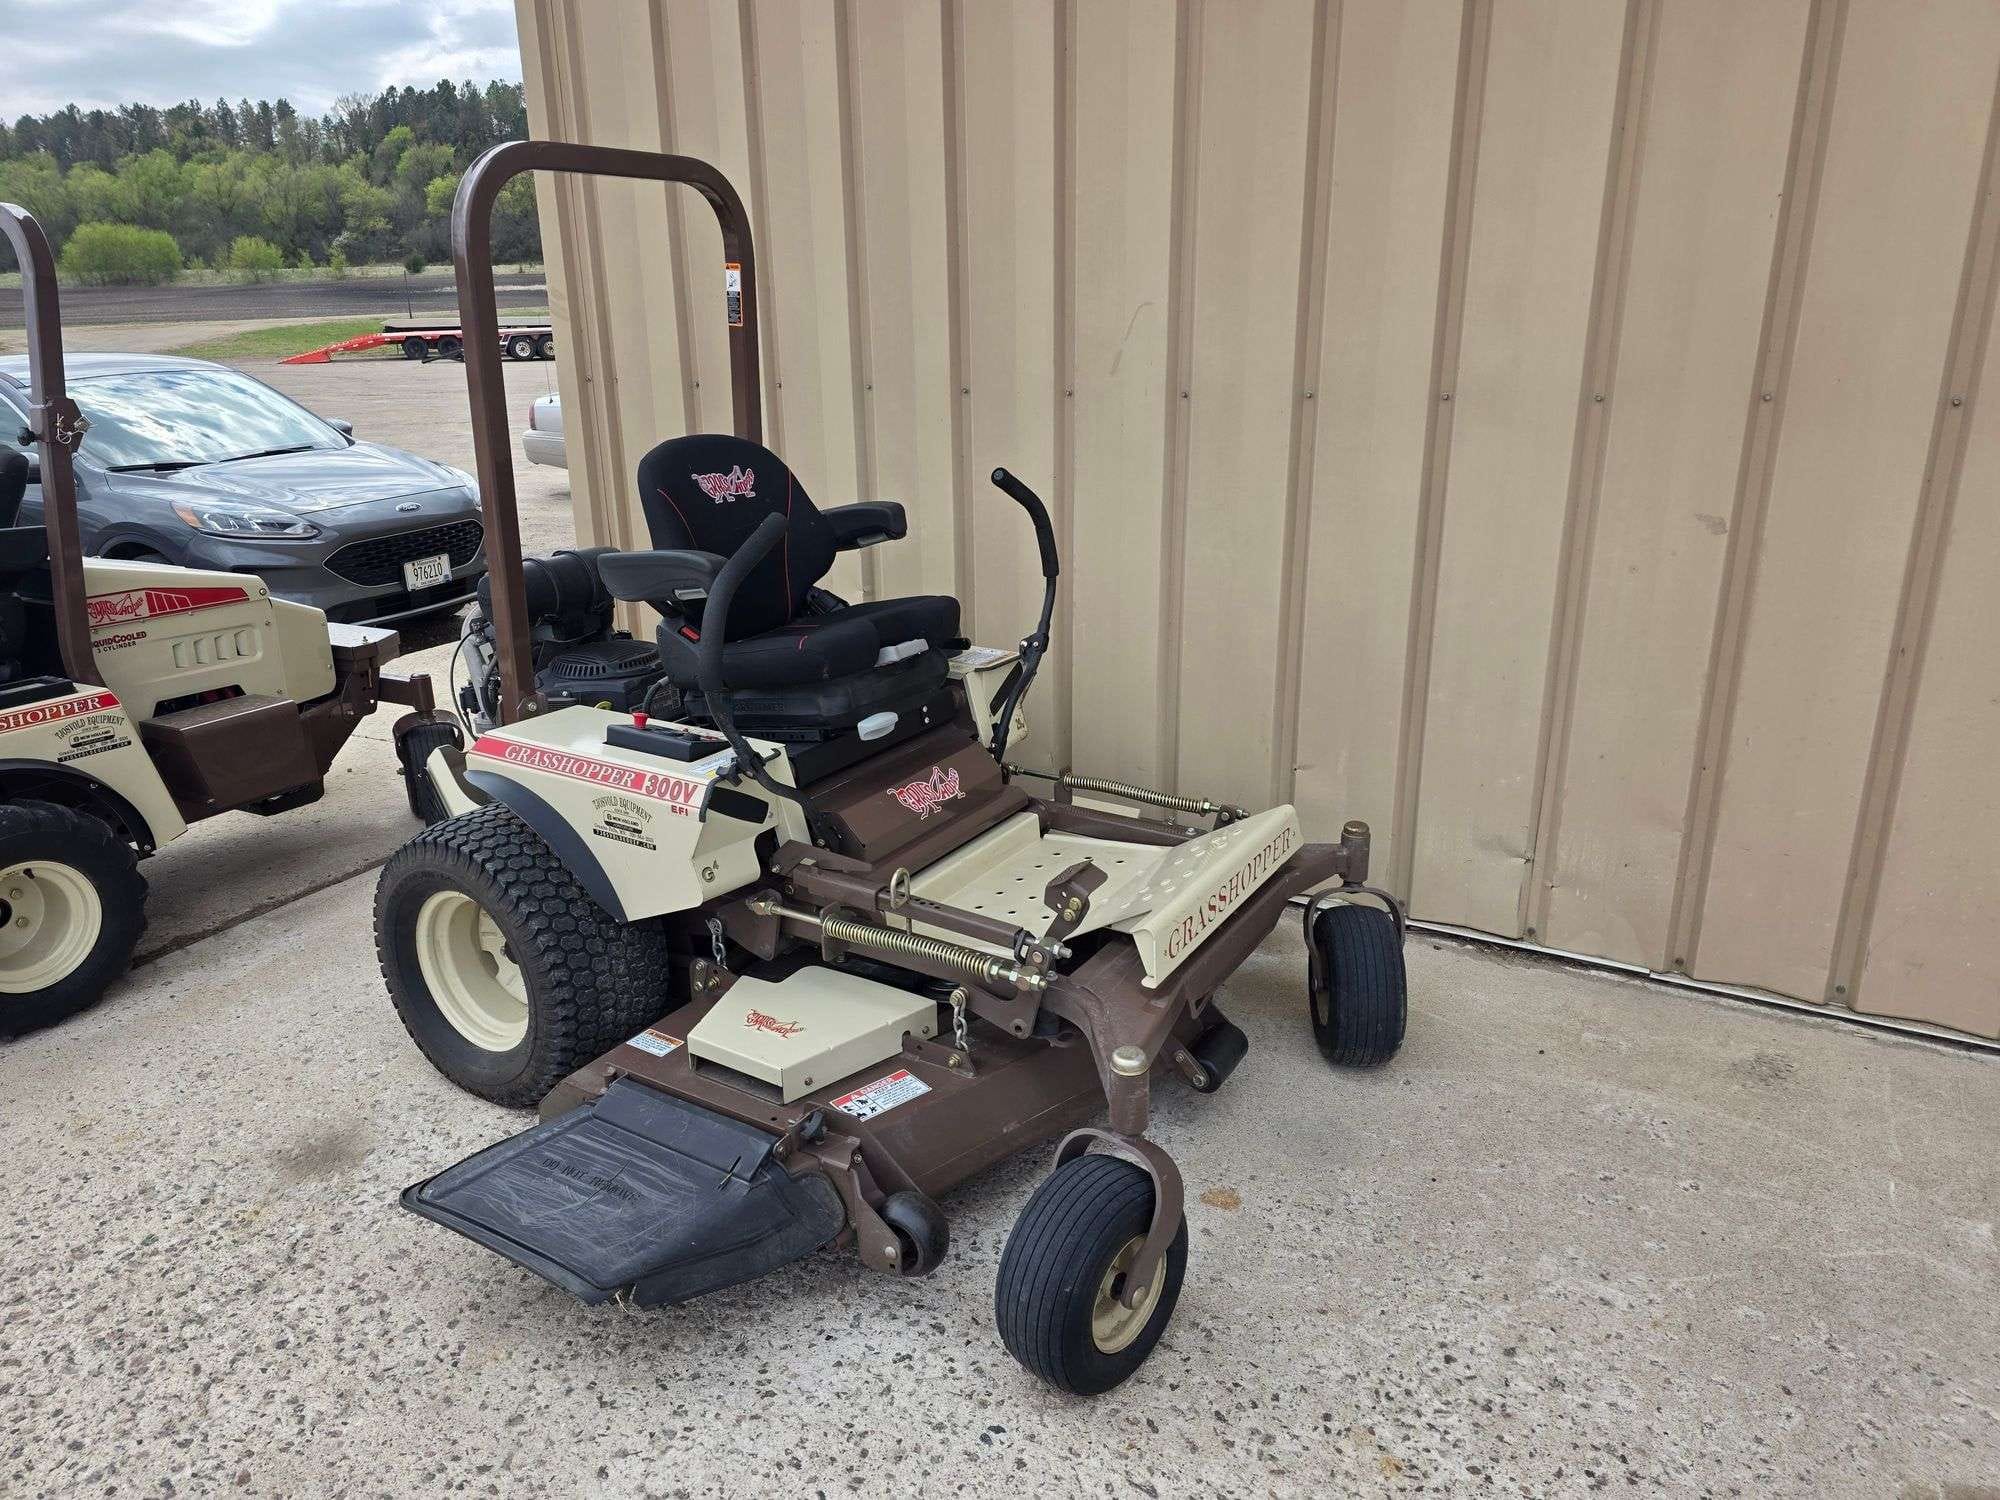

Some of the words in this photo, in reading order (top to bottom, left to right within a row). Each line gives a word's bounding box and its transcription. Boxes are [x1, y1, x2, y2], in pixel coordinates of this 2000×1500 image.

[413, 562, 442, 581] 976210
[103, 640, 137, 652] CYLINDER
[86, 714, 125, 727] EQUIPMENT
[504, 744, 636, 788] GRASSHOPPER
[645, 774, 699, 804] 300V
[671, 804, 688, 817] EFI
[1167, 827, 1291, 959] GRASSHOPPER
[860, 1077, 894, 1094] DANGER
